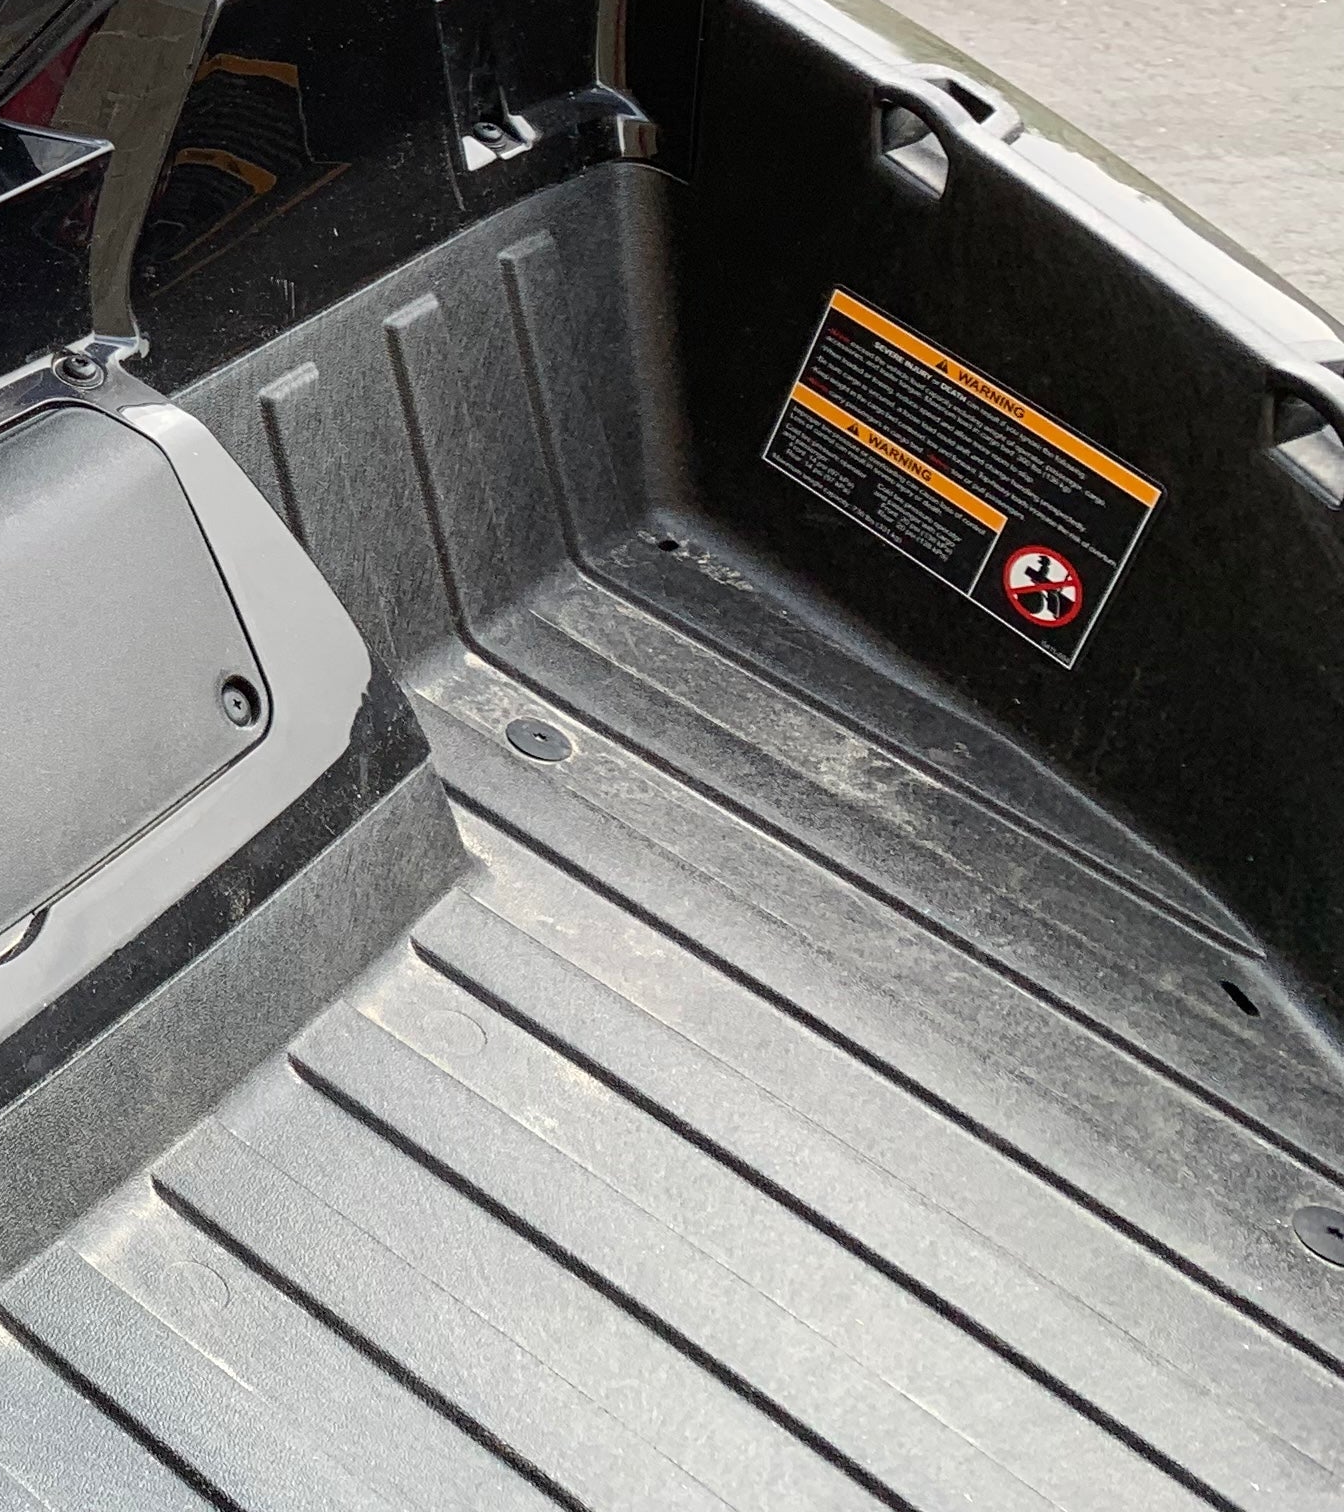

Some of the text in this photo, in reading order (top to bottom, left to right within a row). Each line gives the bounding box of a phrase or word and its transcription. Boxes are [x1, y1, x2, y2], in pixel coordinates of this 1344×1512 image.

[874, 341, 904, 363] SEVERE
[904, 360, 932, 379] INJURY
[940, 382, 966, 402] DEATH
[959, 371, 1024, 418] WARNING
[869, 434, 931, 481] WARNING
